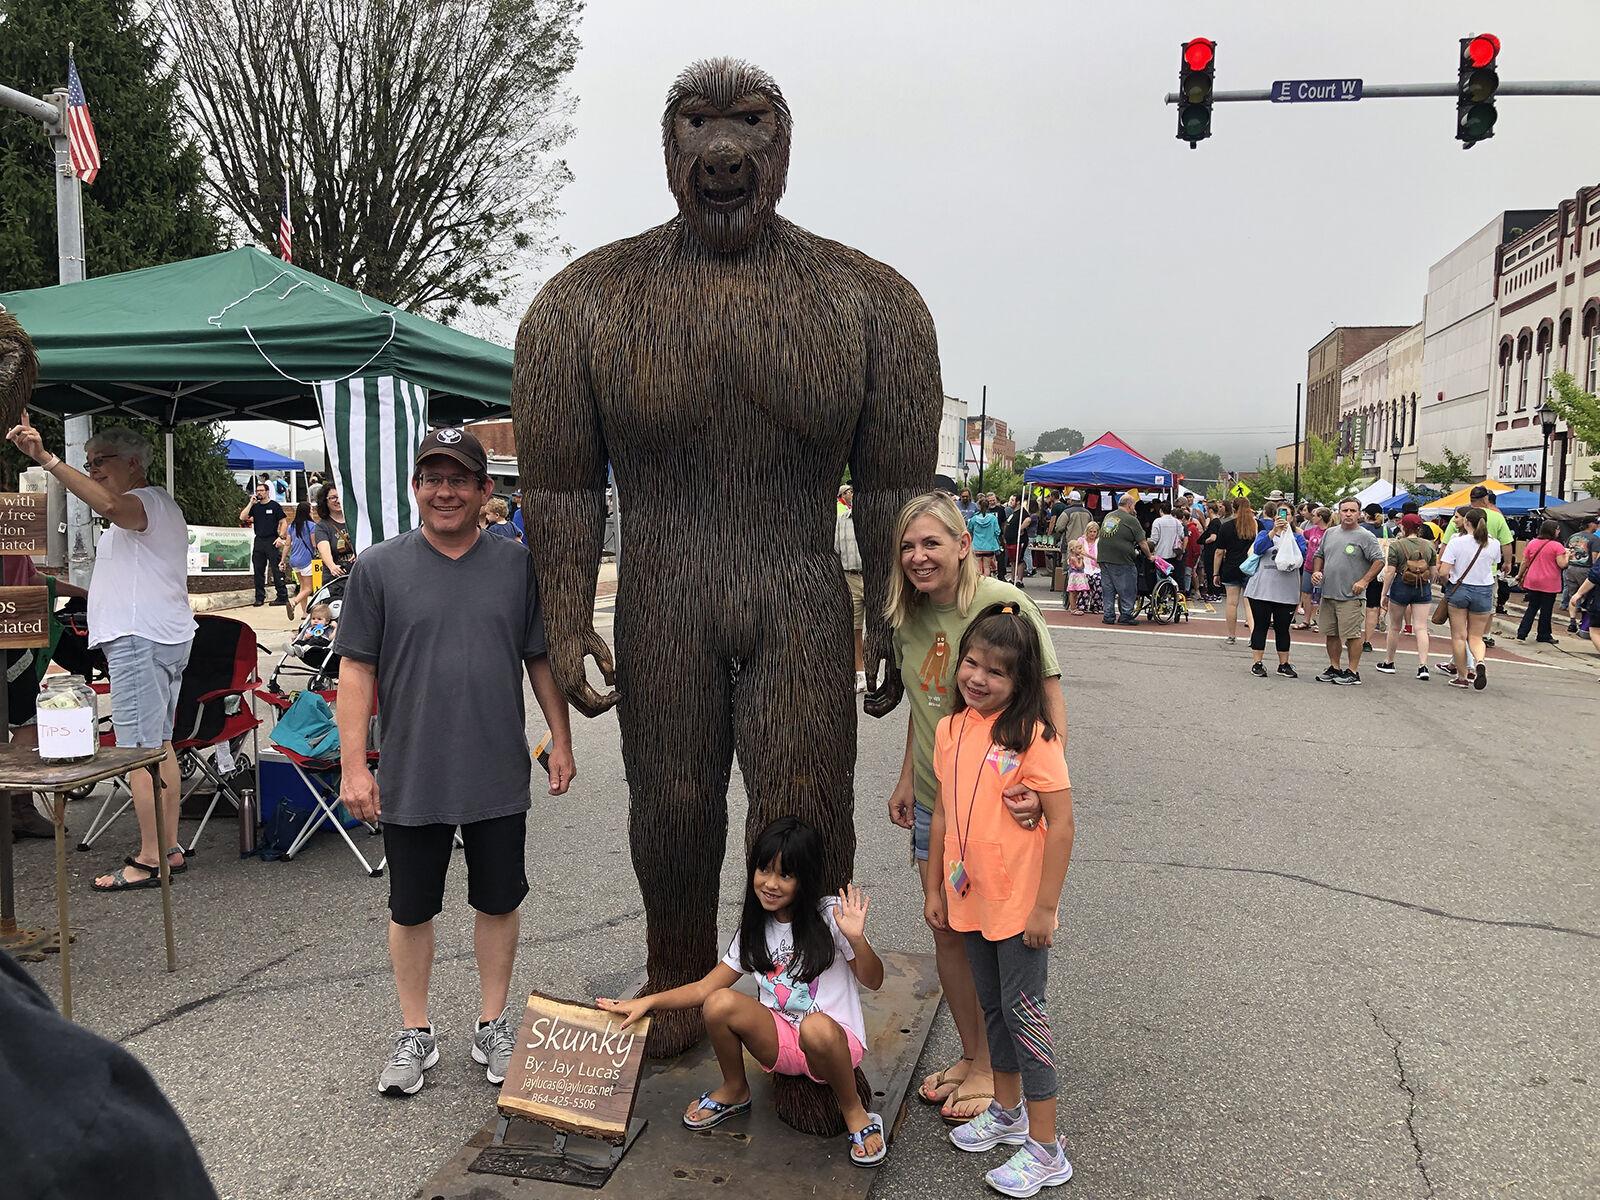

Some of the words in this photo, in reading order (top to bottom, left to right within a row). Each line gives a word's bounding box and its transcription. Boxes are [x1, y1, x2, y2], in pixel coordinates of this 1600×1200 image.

[1281, 82, 1291, 95] E
[1298, 82, 1336, 99] Court
[1341, 80, 1357, 94] W
[1499, 465, 1512, 479] BAIL
[1514, 463, 1537, 479] BONDS
[4, 494, 35, 507] with
[8, 508, 36, 521] free
[527, 1015, 635, 1068] Skunky
[524, 1056, 546, 1074] By:
[549, 1058, 575, 1077] Jay
[578, 1062, 621, 1081] Lucas
[521, 1074, 616, 1098] jaylucas@jaylucas.net
[531, 1093, 597, 1110] 864-425-5506
